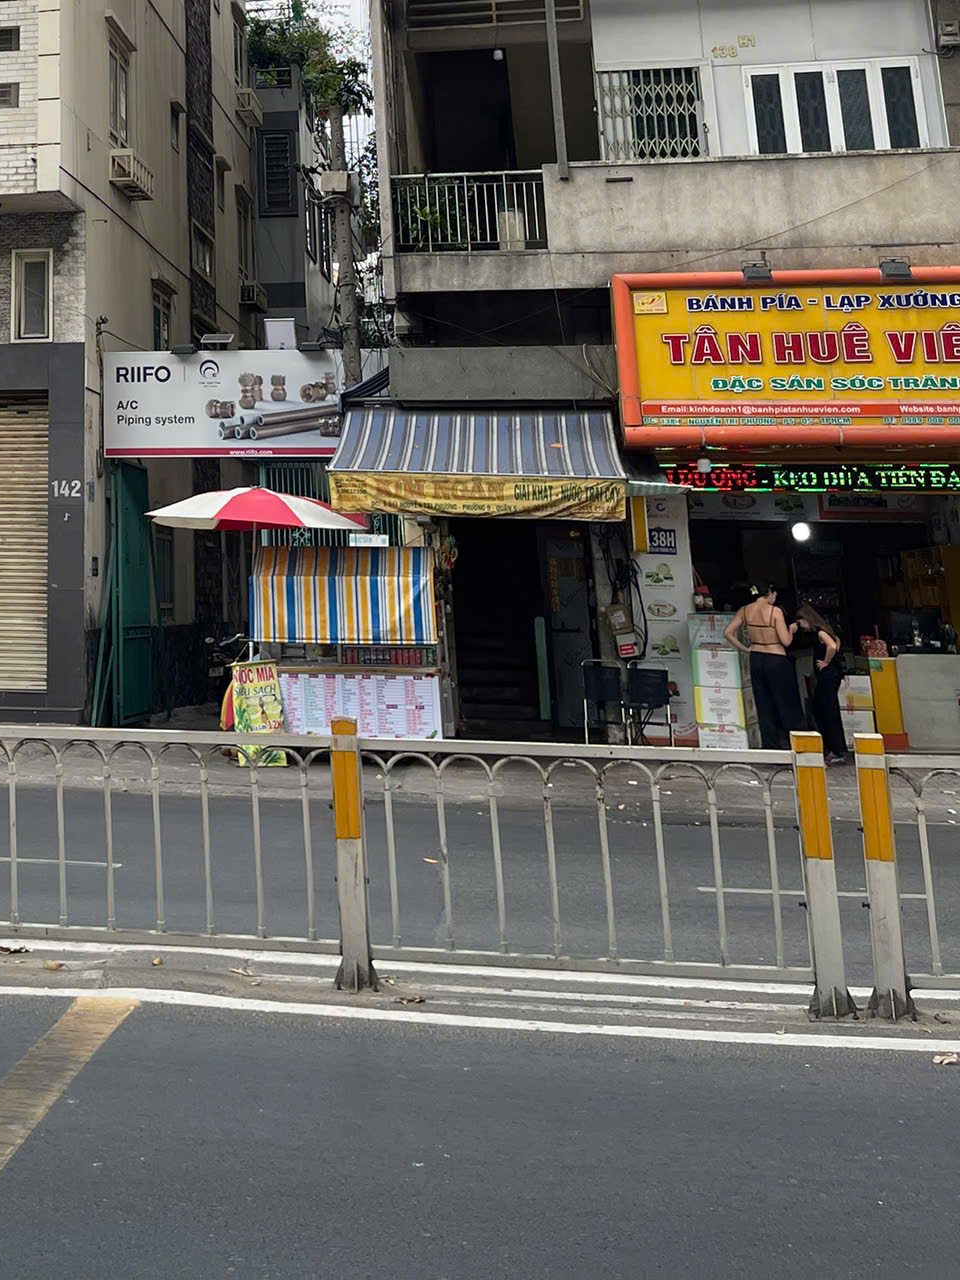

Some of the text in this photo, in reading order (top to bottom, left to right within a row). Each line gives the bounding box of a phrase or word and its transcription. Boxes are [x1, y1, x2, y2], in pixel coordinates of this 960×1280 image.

[711, 33, 756, 58] 138 H1
[687, 293, 754, 311] BÁNH
[760, 292, 803, 311] PÍA
[824, 294, 871, 312] LẠP
[662, 325, 763, 364] TÂN
[772, 322, 872, 364] HUÊ
[116, 365, 171, 383] RIIFO
[711, 374, 960, 393] ĐẶC SẢN SÓC TRĂN
[116, 400, 138, 410] A/C
[117, 415, 195, 426] Piping system
[51, 480, 81, 497] 142
[649, 531, 675, 547] 38H
